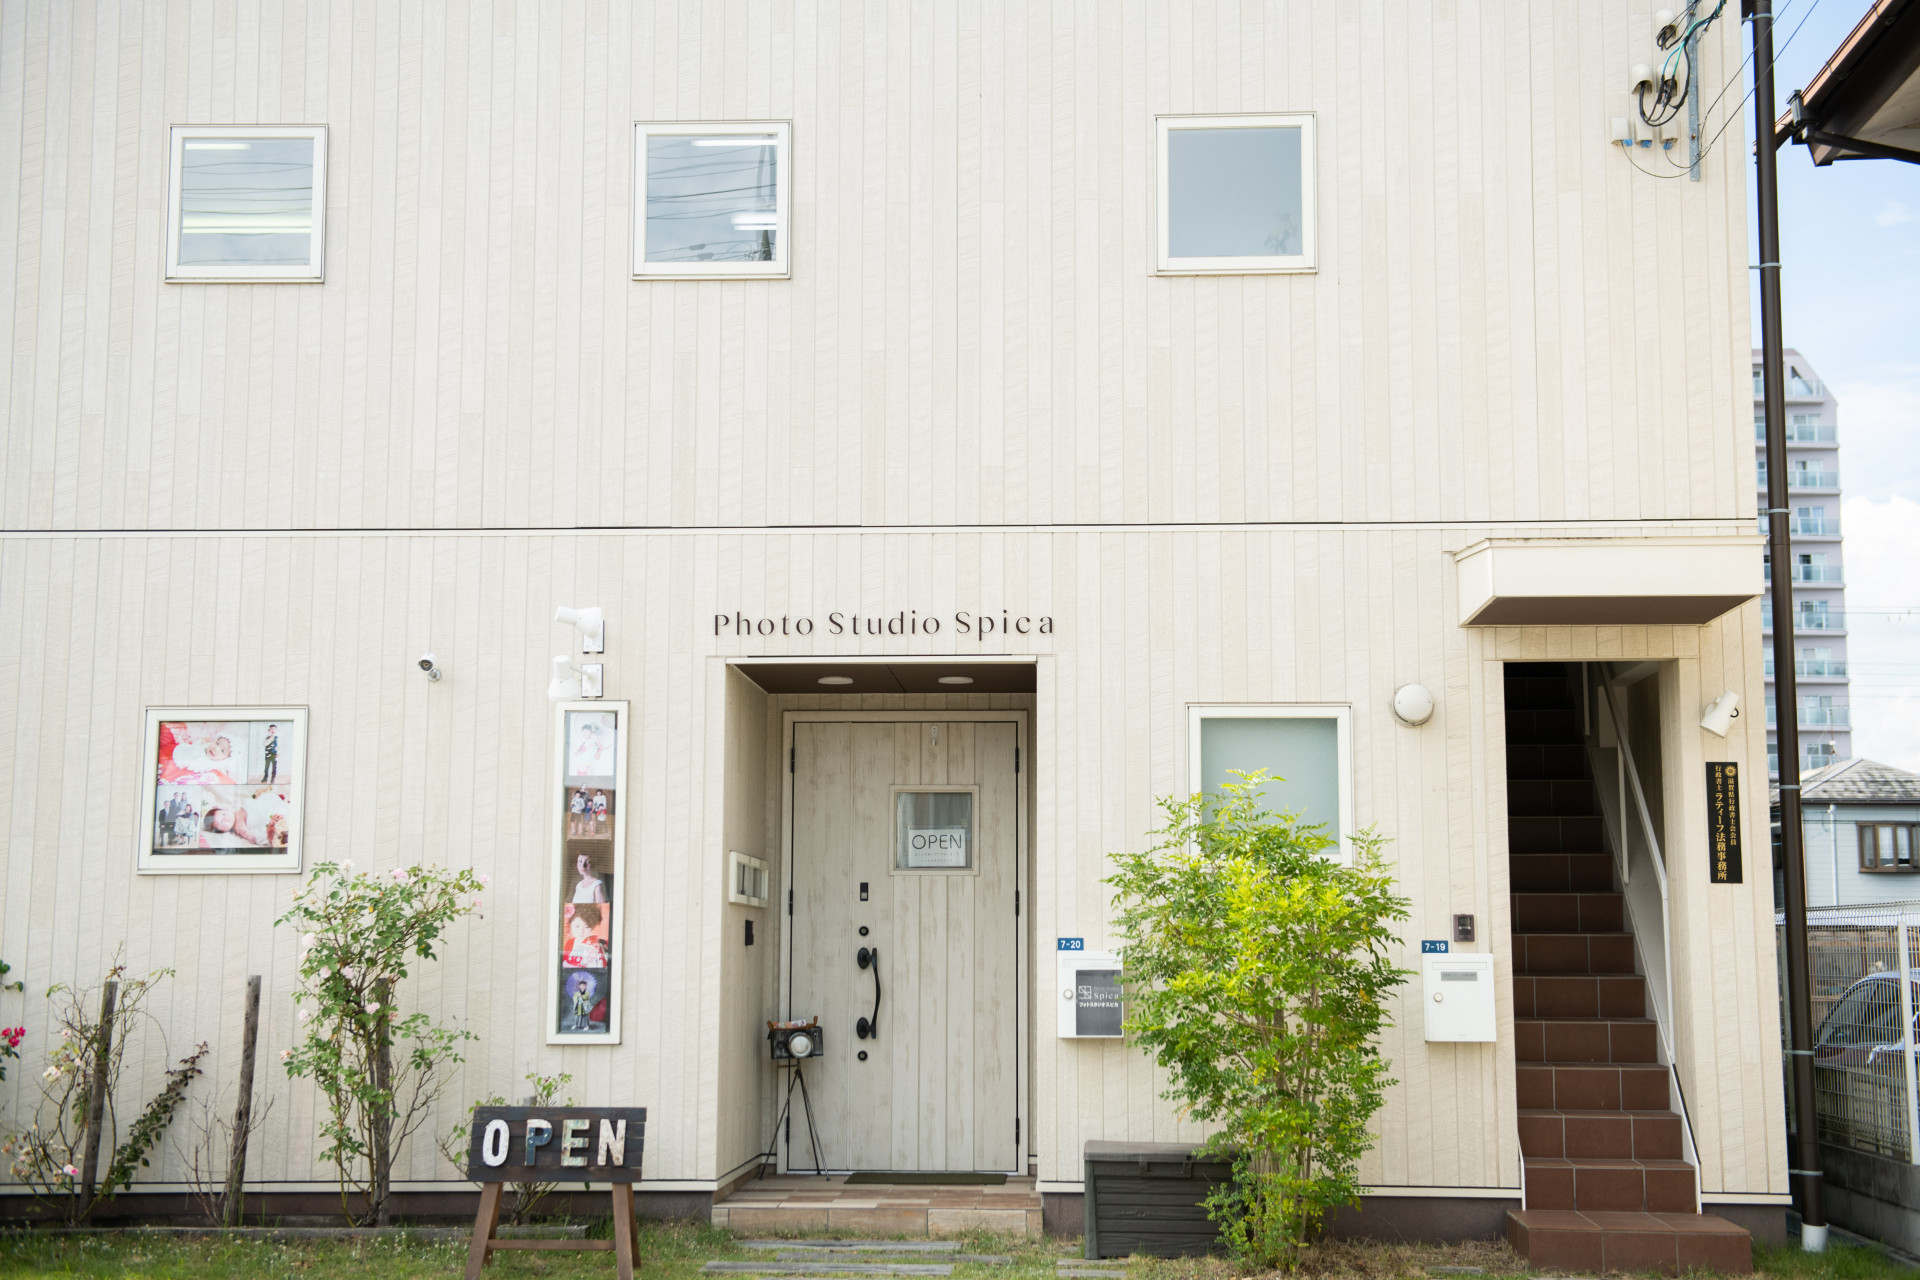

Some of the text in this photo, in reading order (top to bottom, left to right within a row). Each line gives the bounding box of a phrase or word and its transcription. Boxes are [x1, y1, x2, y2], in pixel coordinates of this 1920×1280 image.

[714, 609, 1054, 641] Photo Studio Spica
[912, 834, 962, 850] OPEN
[1060, 940, 1081, 949] 7-20
[1424, 943, 1446, 951] 7-19
[1093, 991, 1119, 1001] Spica
[482, 1118, 627, 1167] OPEN
